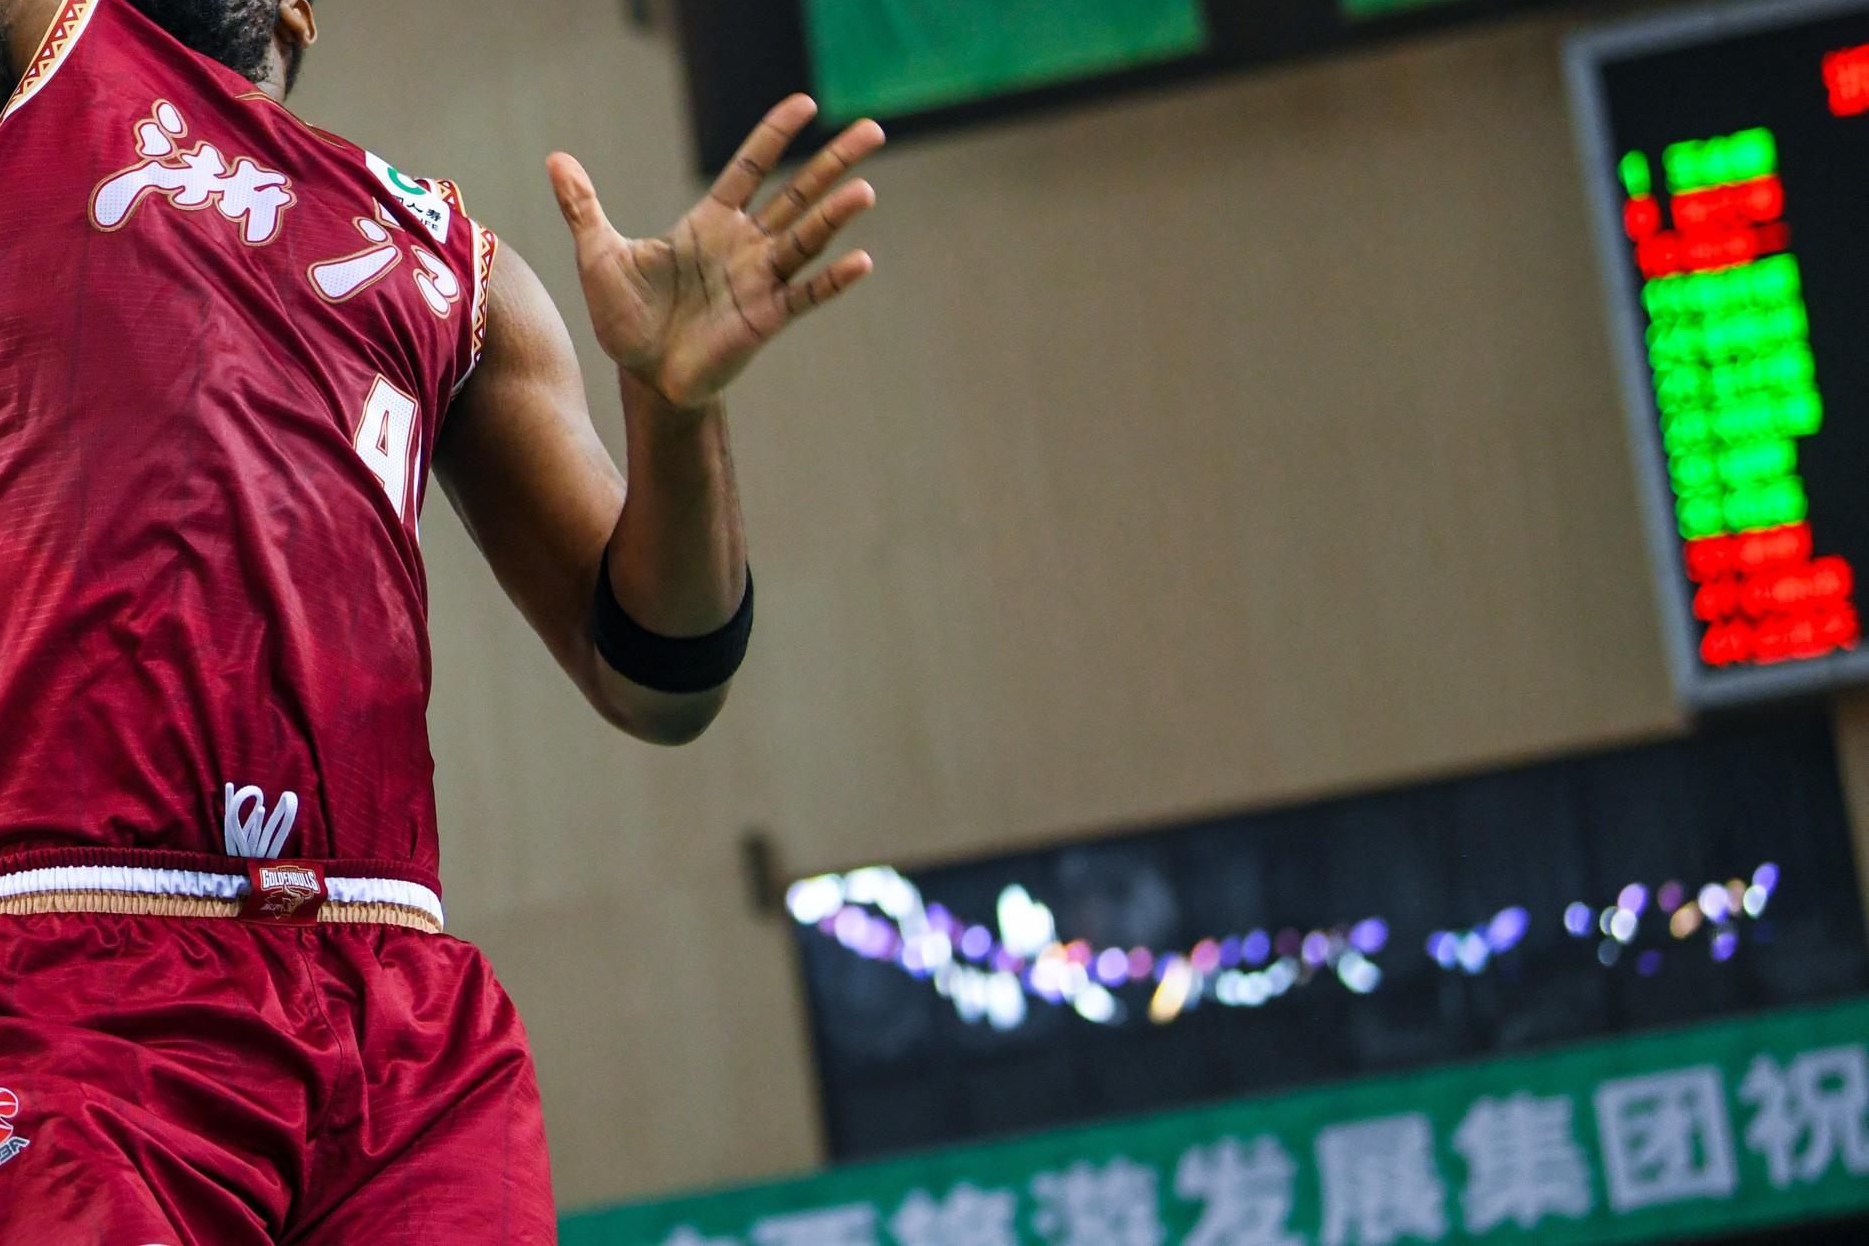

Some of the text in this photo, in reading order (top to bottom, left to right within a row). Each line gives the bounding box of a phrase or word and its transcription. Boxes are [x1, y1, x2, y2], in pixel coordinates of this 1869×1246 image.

[260, 868, 321, 892] GOLDENBULLS
[660, 1042, 1869, 1246] 游发展集团祝
